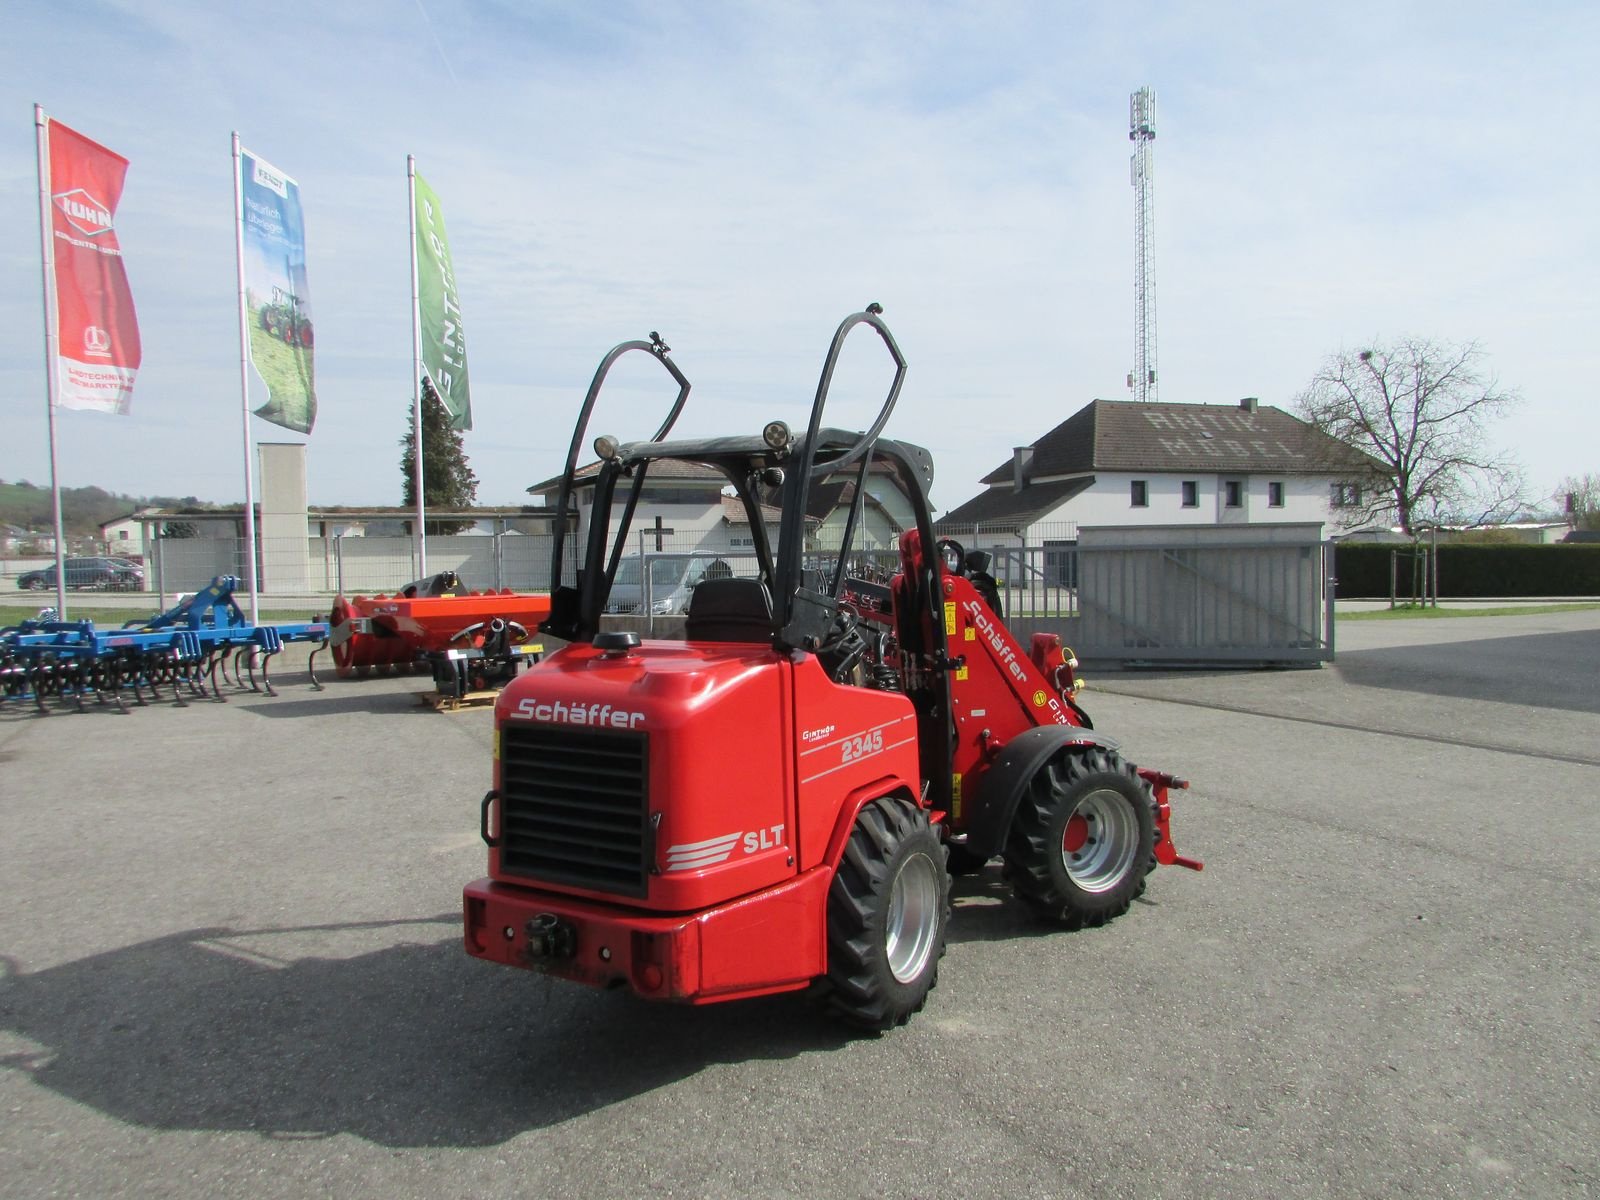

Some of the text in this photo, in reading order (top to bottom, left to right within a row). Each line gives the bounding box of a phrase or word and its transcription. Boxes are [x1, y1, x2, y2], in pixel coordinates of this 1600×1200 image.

[63, 197, 112, 228] KUHN
[962, 600, 1027, 682] Schäffer
[510, 698, 645, 729] Schäffer
[841, 730, 883, 763] 2345
[743, 823, 785, 854] SLT
